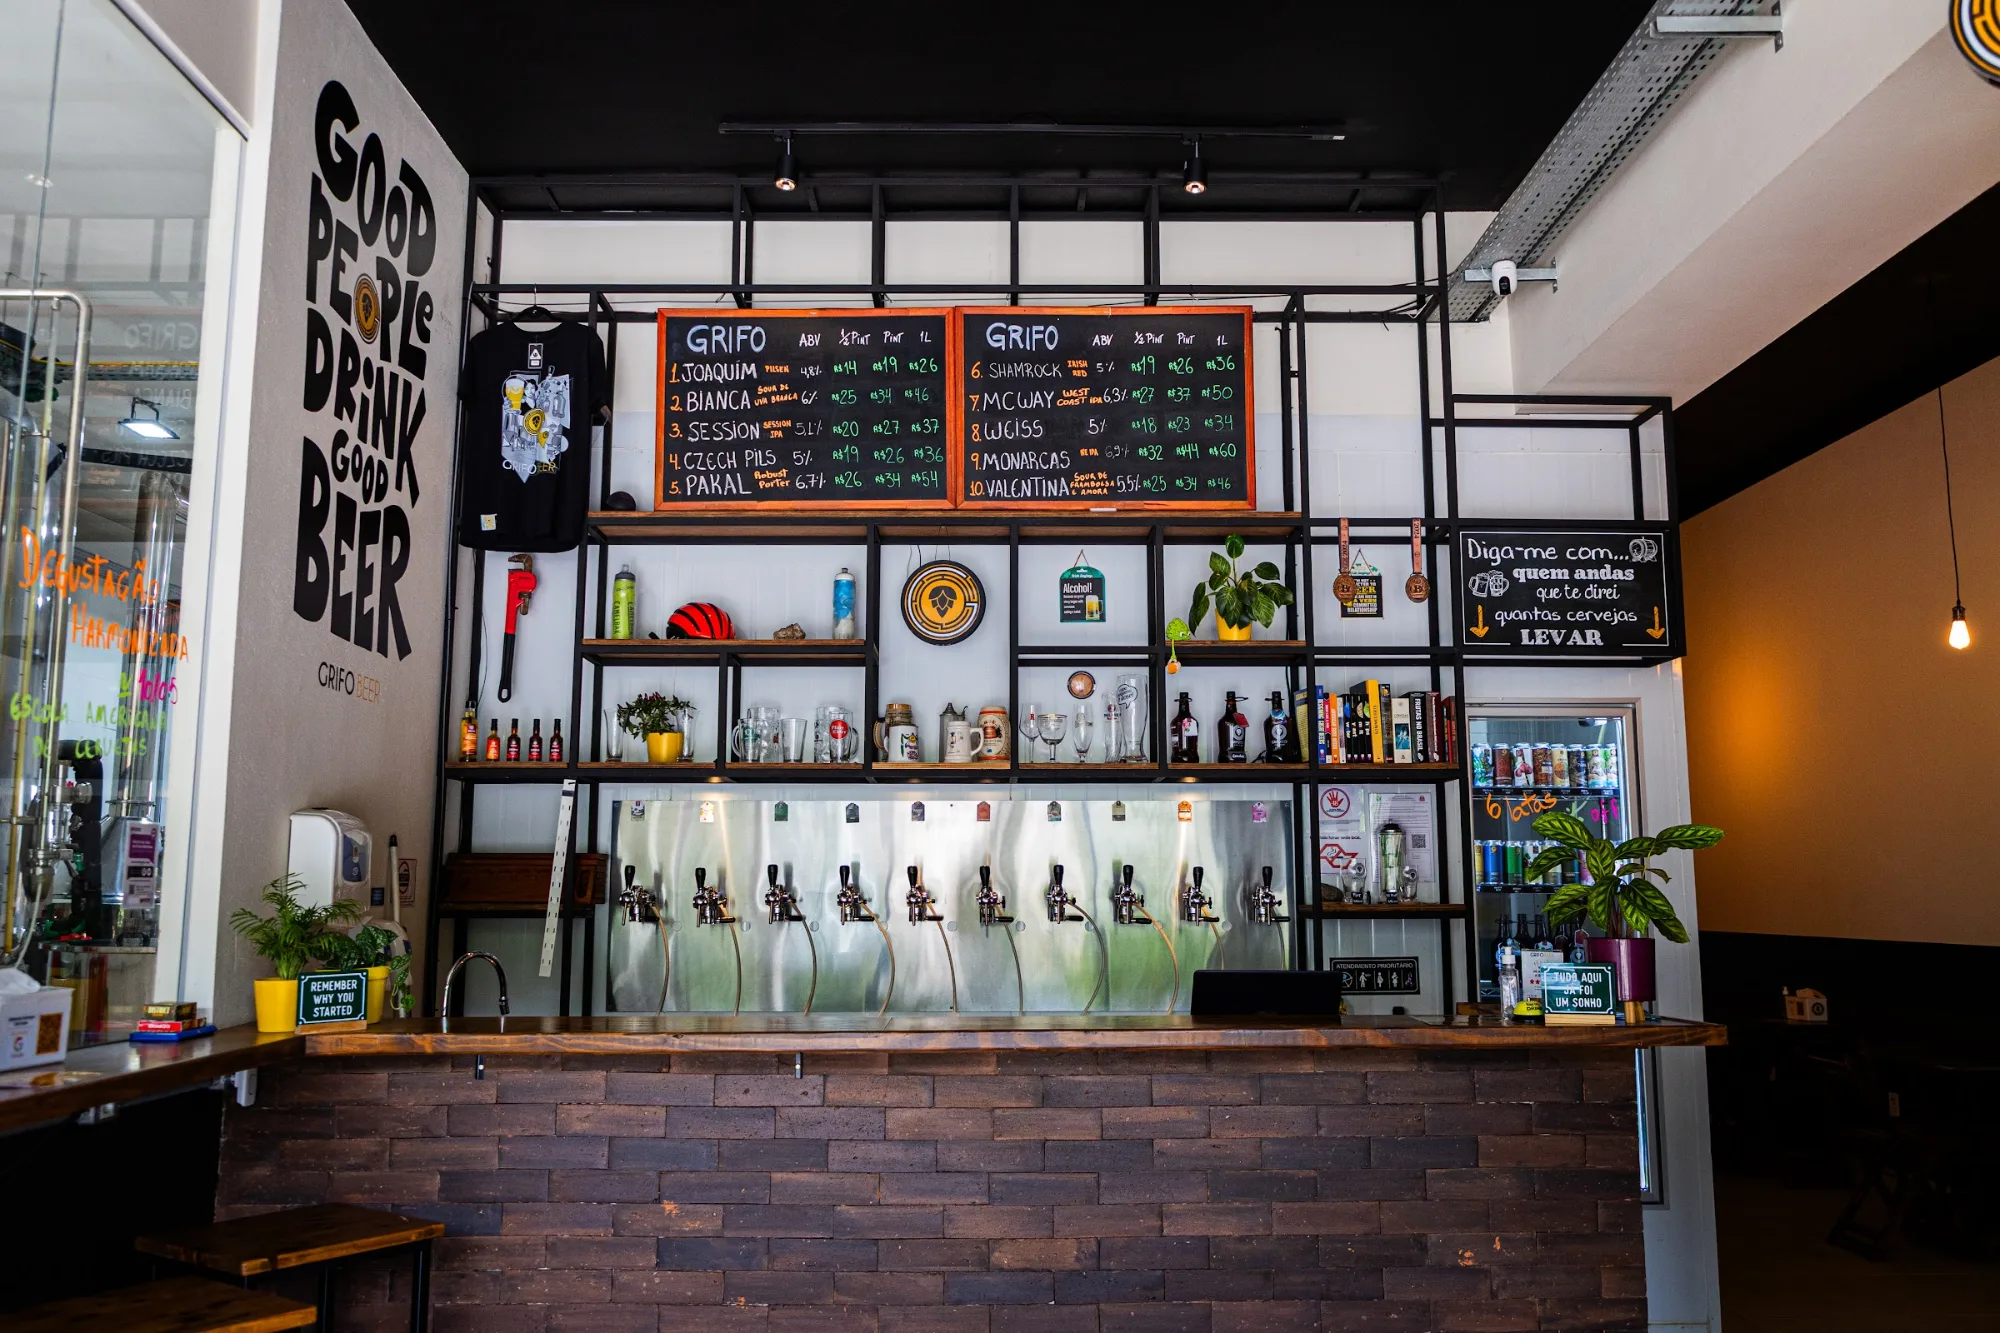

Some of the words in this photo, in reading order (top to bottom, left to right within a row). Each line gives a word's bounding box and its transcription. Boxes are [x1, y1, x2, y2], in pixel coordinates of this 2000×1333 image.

[314, 80, 437, 277] GOOD
[686, 325, 766, 354] GRIFO
[799, 333, 821, 347] ABV
[920, 331, 932, 343] 1L
[985, 322, 1059, 351] GRIFO
[1092, 333, 1114, 346] ABV
[1217, 333, 1228, 346] 1L
[681, 360, 757, 382] JOAQUIM
[764, 365, 790, 373] PILSEN
[834, 360, 857, 375] R$14
[872, 356, 898, 373] R$19
[909, 358, 938, 373] R$26
[988, 362, 1063, 379] SHAMROCK
[1072, 369, 1088, 377] RED
[1096, 361, 1115, 373] 5%
[1131, 355, 1156, 374] R$19
[1168, 357, 1194, 374] R$26
[1206, 355, 1236, 371] R$36
[754, 398, 768, 406] UVA
[771, 392, 798, 403] BRANCA
[801, 390, 818, 405] 6%
[832, 390, 857, 405] R$25
[870, 389, 893, 404] R$34
[904, 388, 929, 401] R$46
[757, 385, 777, 395] SOUR
[1056, 396, 1088, 407] COAST
[1132, 386, 1155, 403] R$27
[1167, 386, 1191, 402] R$37
[1201, 384, 1233, 400] R$50
[1062, 387, 1091, 398] WEST
[303, 308, 427, 509] DRINK
[687, 390, 751, 412] BIANCA
[687, 421, 760, 442] SESSION
[763, 420, 792, 429] SESSION
[832, 421, 859, 437] R$20
[873, 420, 900, 435] R$27
[911, 418, 939, 434] R$37
[770, 430, 783, 439] IPA
[984, 418, 1044, 441] WEISS
[1088, 418, 1108, 435] 5%
[1131, 417, 1157, 434] R$18
[1168, 416, 1191, 432] R$23
[1204, 415, 1233, 431] R$34
[684, 451, 737, 470] CZECH
[745, 448, 777, 468] PILS
[793, 450, 813, 466] 5%
[832, 445, 860, 463] R$19
[873, 447, 904, 464] R$26
[914, 446, 944, 463] R$36
[982, 451, 1071, 471] MONARCAS
[1138, 444, 1164, 461] R$32
[1176, 443, 1200, 459] R$44
[1209, 442, 1237, 458] R$60
[331, 429, 389, 504] GOOD
[502, 459, 537, 474] GRIFO
[687, 474, 752, 496] PAKAL
[834, 471, 862, 488] R$26
[875, 472, 901, 488] R$34
[911, 471, 939, 488] R$54
[1074, 472, 1096, 481] SOUR
[1143, 475, 1167, 492] R$25
[1175, 475, 1198, 491] R$34
[1207, 477, 1232, 490] R$46
[985, 476, 1070, 498] VALENTINA
[1080, 487, 1108, 495] AMORA
[293, 435, 412, 662] BEER
[1467, 538, 1558, 566] Diga-me
[1512, 567, 1569, 582] quem
[1574, 564, 1635, 581] andas
[1063, 582, 1093, 593] Alcohol!
[1536, 586, 1562, 602] que
[1564, 584, 1582, 599] te
[1584, 584, 1621, 600] direi
[1494, 606, 1561, 627] quantas
[1566, 608, 1638, 625] cervejas
[71, 602, 190, 662] HARMONIZADA
[1520, 629, 1604, 646] LEVAR
[317, 661, 355, 696] GRIFO
[356, 674, 381, 704] BEER
[1414, 698, 1422, 720] FRUTAS
[1416, 731, 1424, 751] BRASIL
[1485, 793, 1501, 819] 6
[310, 979, 358, 992] REMEMBER
[1554, 972, 1578, 982] TUDO
[1581, 972, 1602, 984] AQUI
[313, 993, 334, 1005] WHY
[337, 992, 354, 1003] YOU
[1579, 985, 1593, 995] FOI
[312, 1005, 353, 1018] STARTED
[1555, 997, 1569, 1007] UM
[1572, 998, 1602, 1008] SONHO
